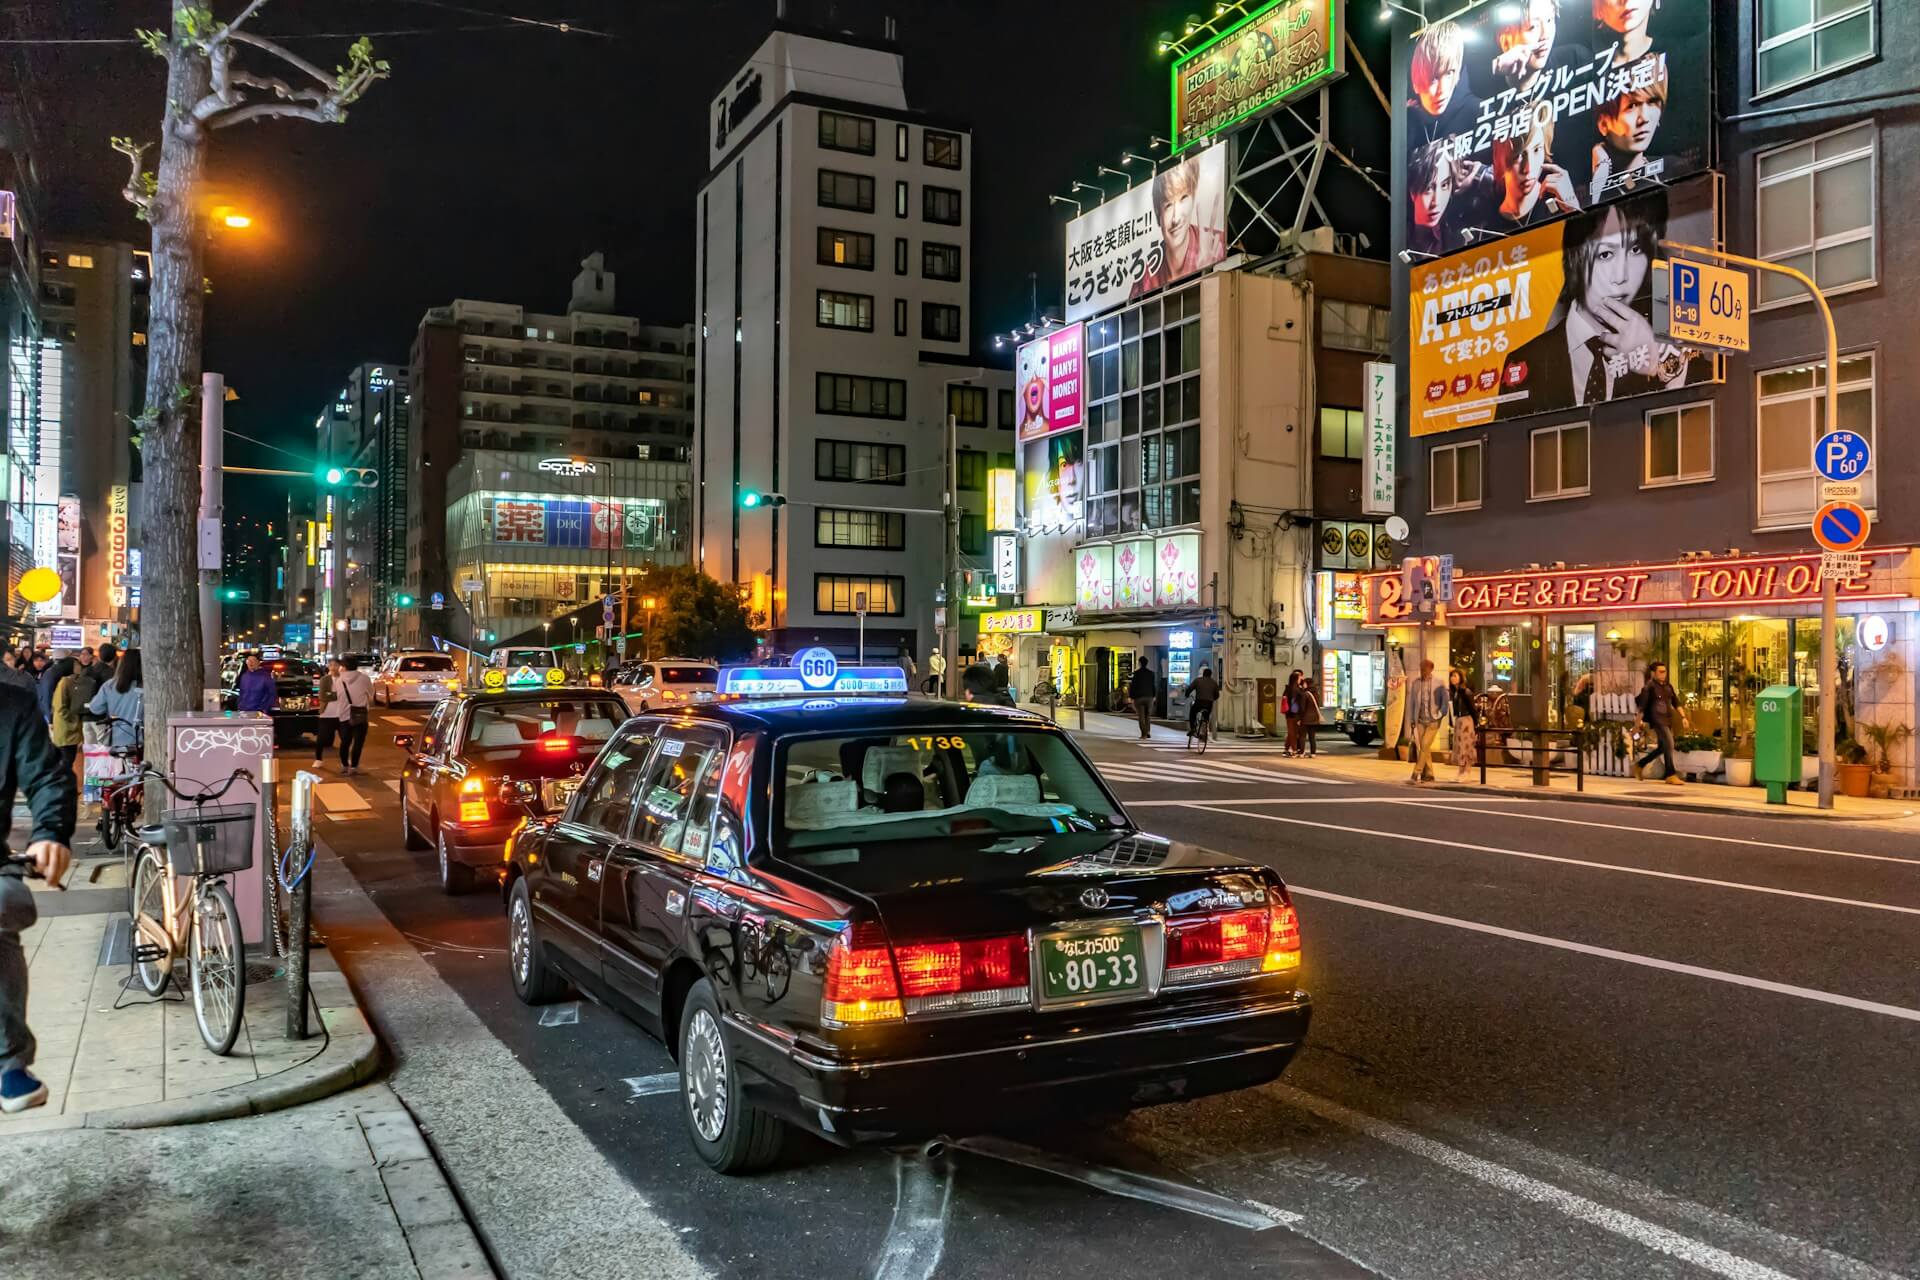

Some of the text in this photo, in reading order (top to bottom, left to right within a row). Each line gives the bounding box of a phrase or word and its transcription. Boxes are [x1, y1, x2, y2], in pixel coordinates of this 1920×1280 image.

[1188, 29, 1320, 122] チャペルクリスマス
[1248, 58, 1325, 111] 06-6212-7322
[1476, 41, 1619, 124] エアーグループ
[1068, 240, 1165, 306] こうざぶろう
[1422, 244, 1529, 295] あなたの人生
[1680, 269, 1695, 301] P
[1419, 271, 1532, 345] ATOM
[1445, 298, 1502, 322] アトムグループ
[1675, 305, 1697, 322] 8-19
[1440, 331, 1510, 364] で変わる
[538, 462, 597, 474] DOTON
[1826, 442, 1848, 474] P
[556, 518, 581, 529] DHC
[1002, 538, 1014, 579] ラーメン
[1457, 575, 1649, 609] CAFE & REST
[1689, 565, 1778, 599] TONI
[803, 659, 834, 677] 660
[1762, 701, 1777, 712] 60
[907, 736, 966, 750] 1736
[1065, 954, 1138, 991] 80-33
